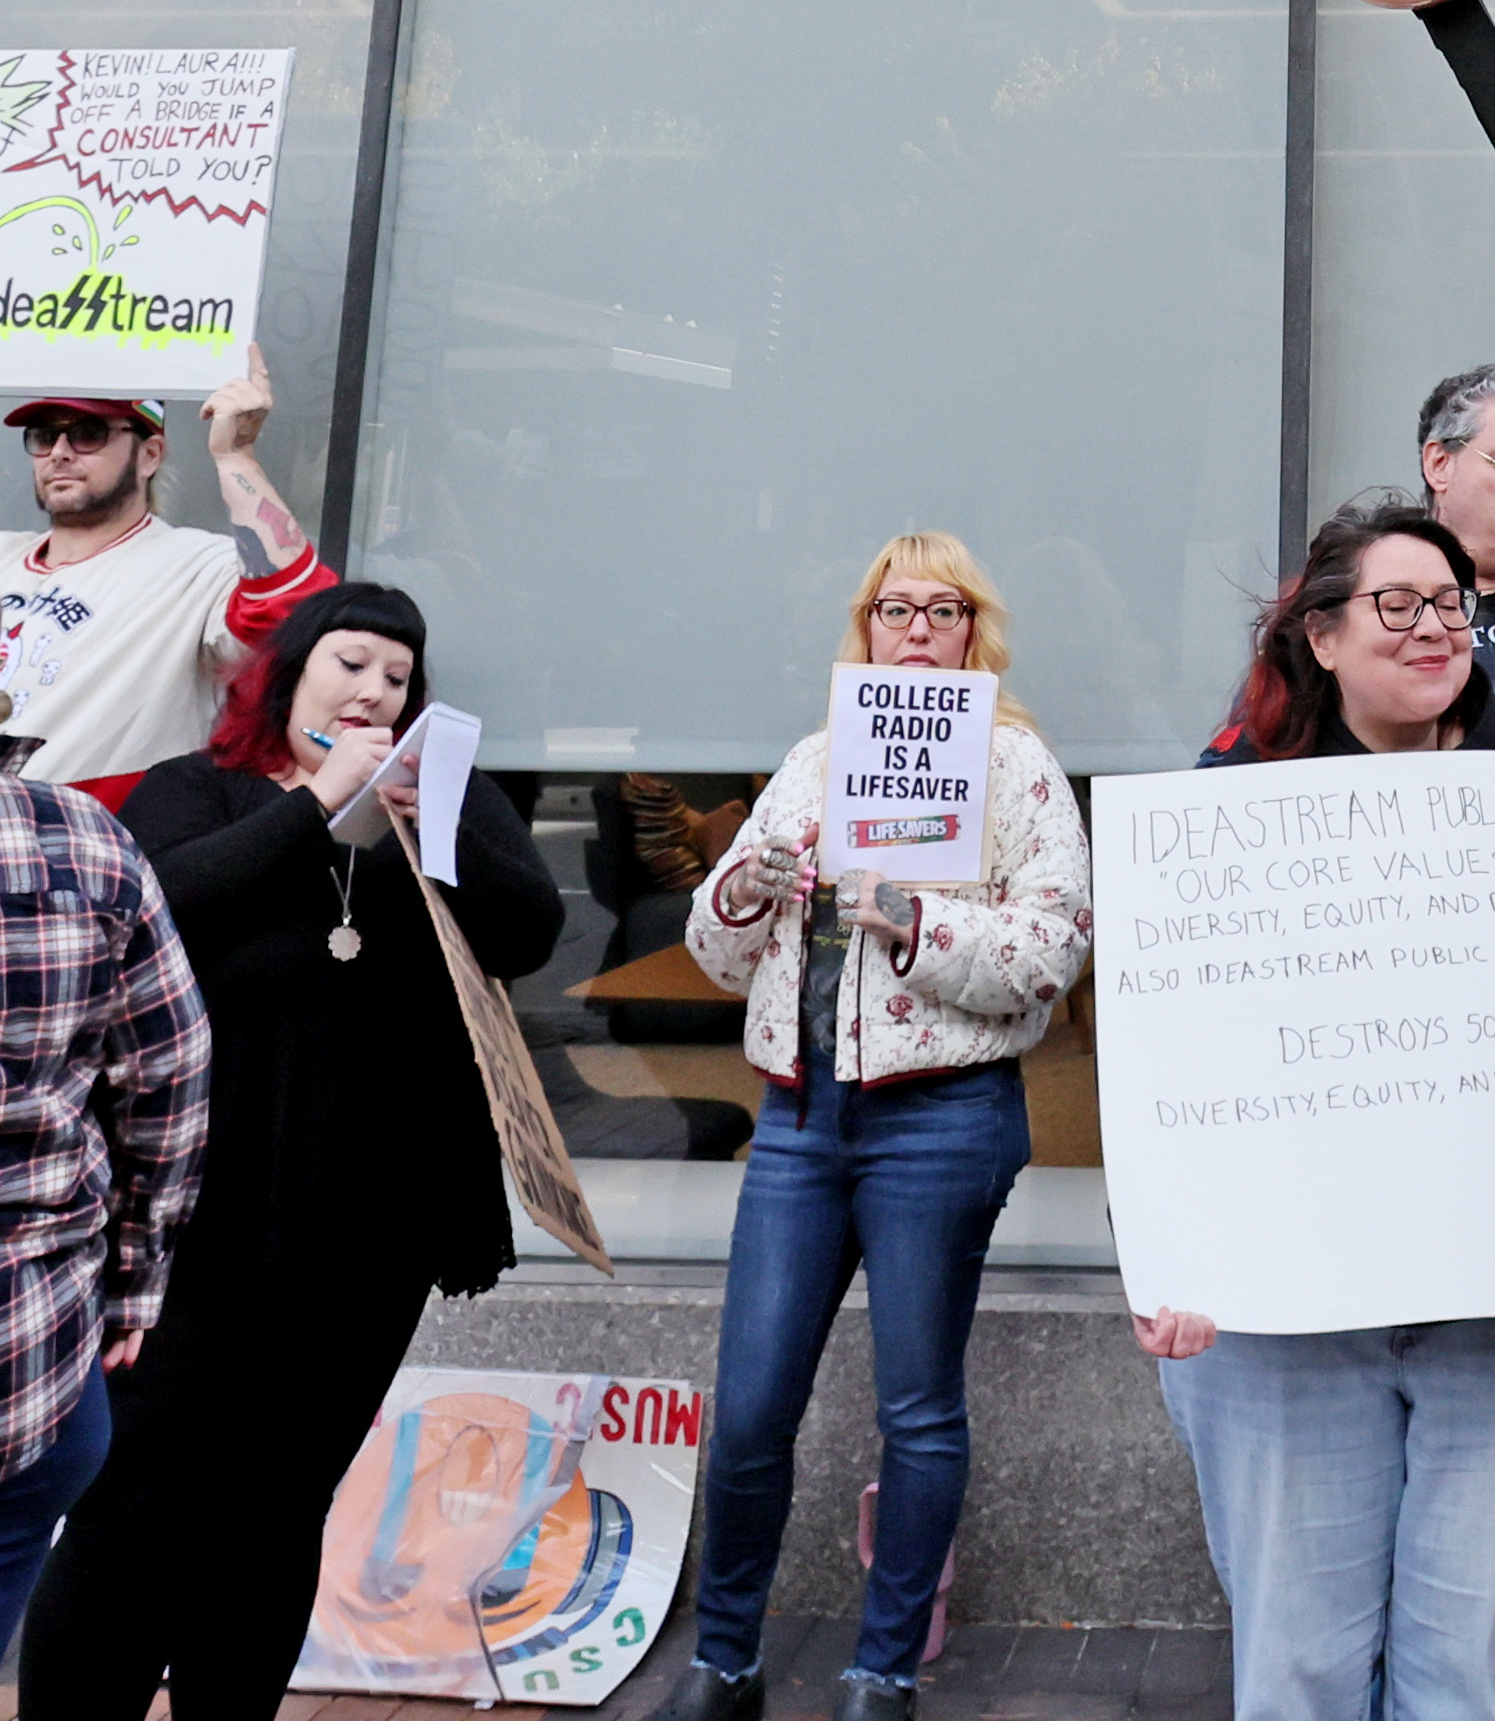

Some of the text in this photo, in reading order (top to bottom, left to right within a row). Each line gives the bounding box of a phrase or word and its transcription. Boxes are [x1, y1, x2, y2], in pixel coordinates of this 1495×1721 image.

[83, 52, 265, 79] KEVIN! LAURA!!!
[80, 81, 140, 102] WOULD
[201, 78, 276, 97] JUMP
[70, 99, 274, 124] OFF A BRIDGE IF A
[77, 122, 270, 157] CONSULTANT
[107, 155, 272, 185] TOLD YOU?
[857, 682, 971, 713] COLLEGE
[870, 714, 953, 743] RADIO
[884, 745, 932, 772] IS A
[845, 773, 970, 803] LIFESAVER
[1131, 789, 1405, 864] IDEASTREAM
[1266, 855, 1353, 891] CORE
[1135, 907, 1286, 951] DIVERSITY,
[1304, 894, 1411, 929] EQUITY,
[1428, 892, 1480, 916] AND
[1118, 968, 1180, 995] ALSO
[1198, 948, 1373, 985] IDEASTREAM
[1391, 945, 1488, 969] PUBLIC
[1278, 1015, 1449, 1064] DESTROYS
[1156, 1091, 1317, 1128] DIVERSITY,
[1326, 1079, 1445, 1109] EQUITY,
[555, 1381, 702, 1448] MUSC
